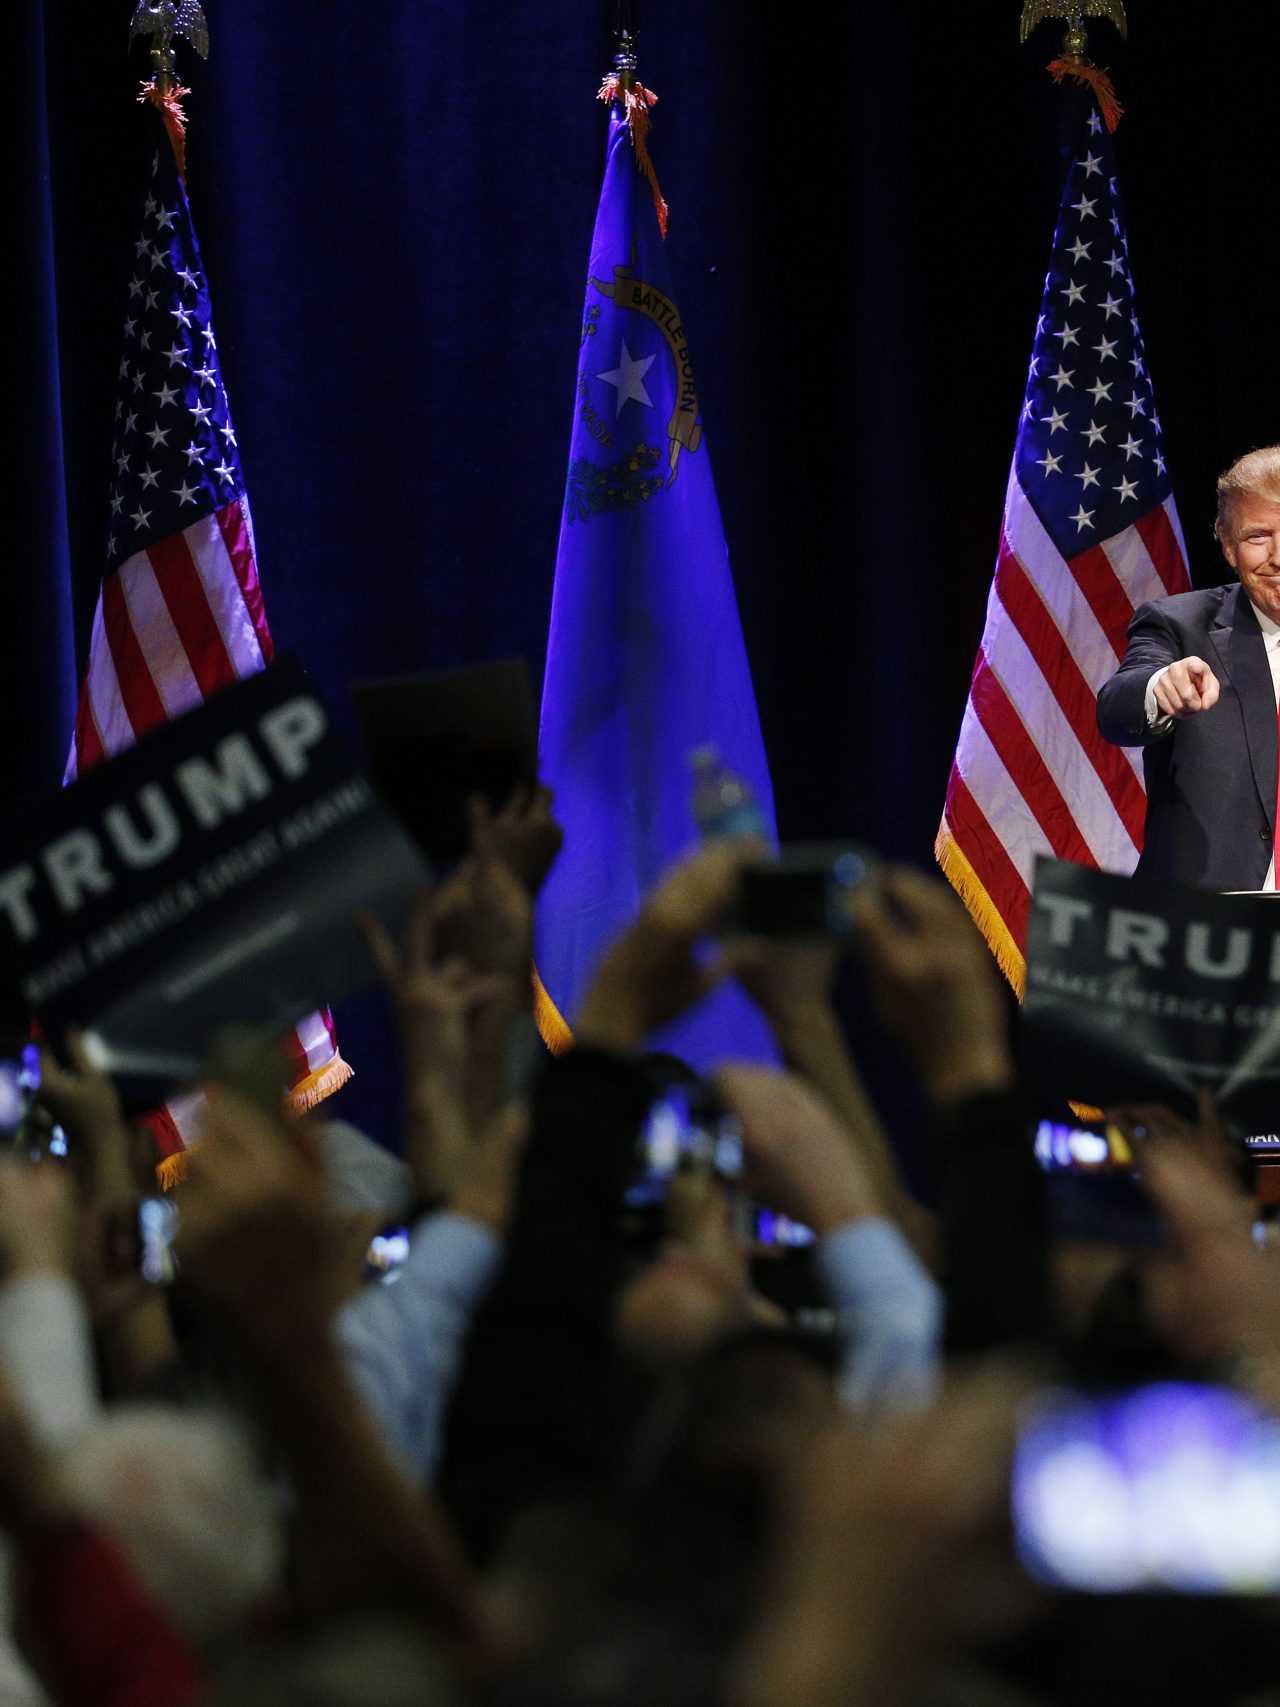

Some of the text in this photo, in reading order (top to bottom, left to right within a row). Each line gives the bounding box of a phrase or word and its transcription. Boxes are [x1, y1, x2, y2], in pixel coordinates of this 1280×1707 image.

[632, 286, 695, 412] BATTLE BORN
[0, 694, 330, 944] TRUMP
